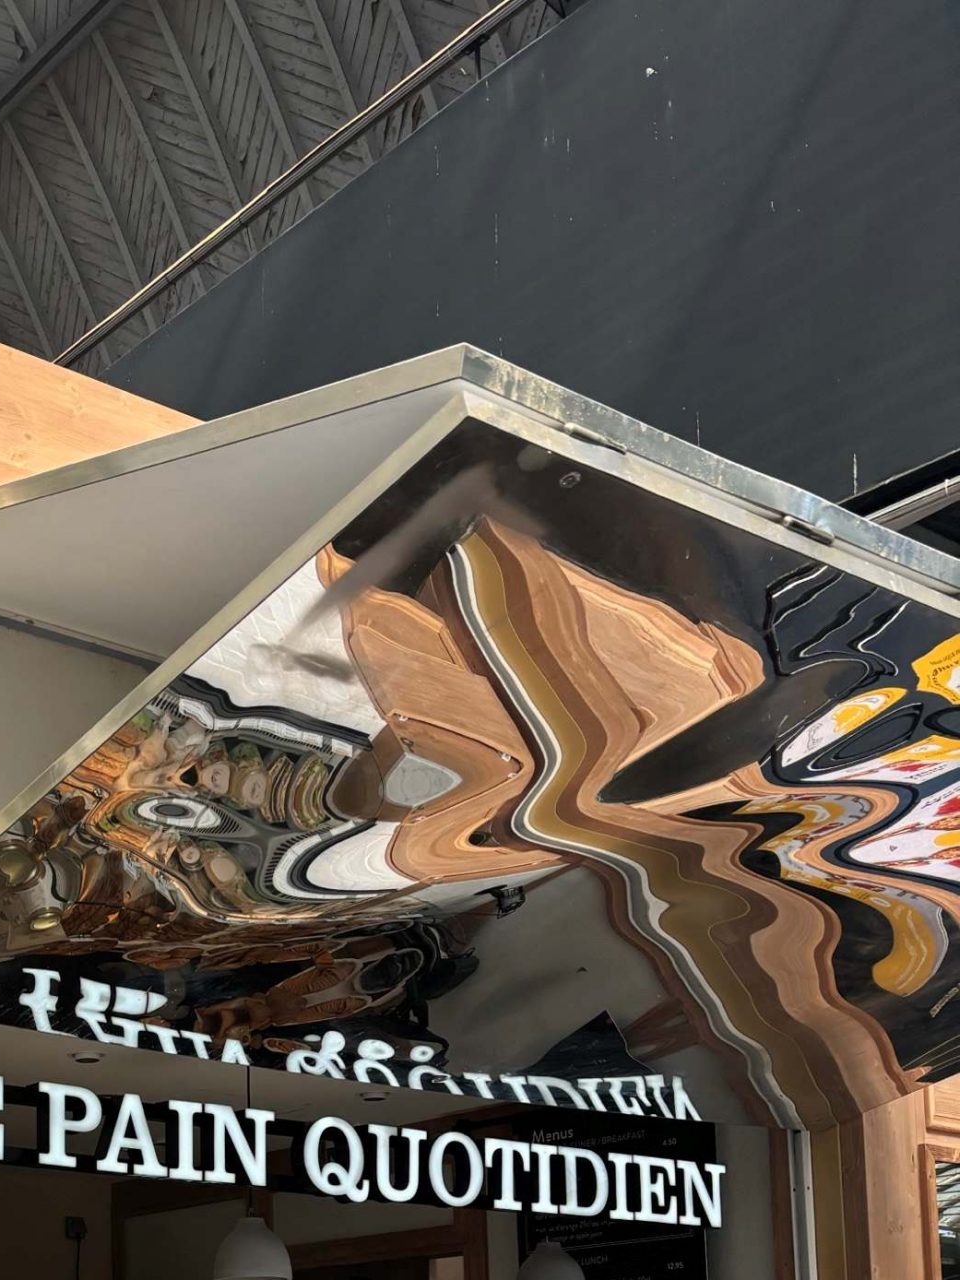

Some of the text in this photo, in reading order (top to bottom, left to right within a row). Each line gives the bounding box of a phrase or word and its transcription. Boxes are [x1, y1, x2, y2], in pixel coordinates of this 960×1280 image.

[38, 1081, 275, 1186] PAIN
[303, 1116, 726, 1228] QUOTIDIEN
[531, 1129, 574, 1143] Menus
